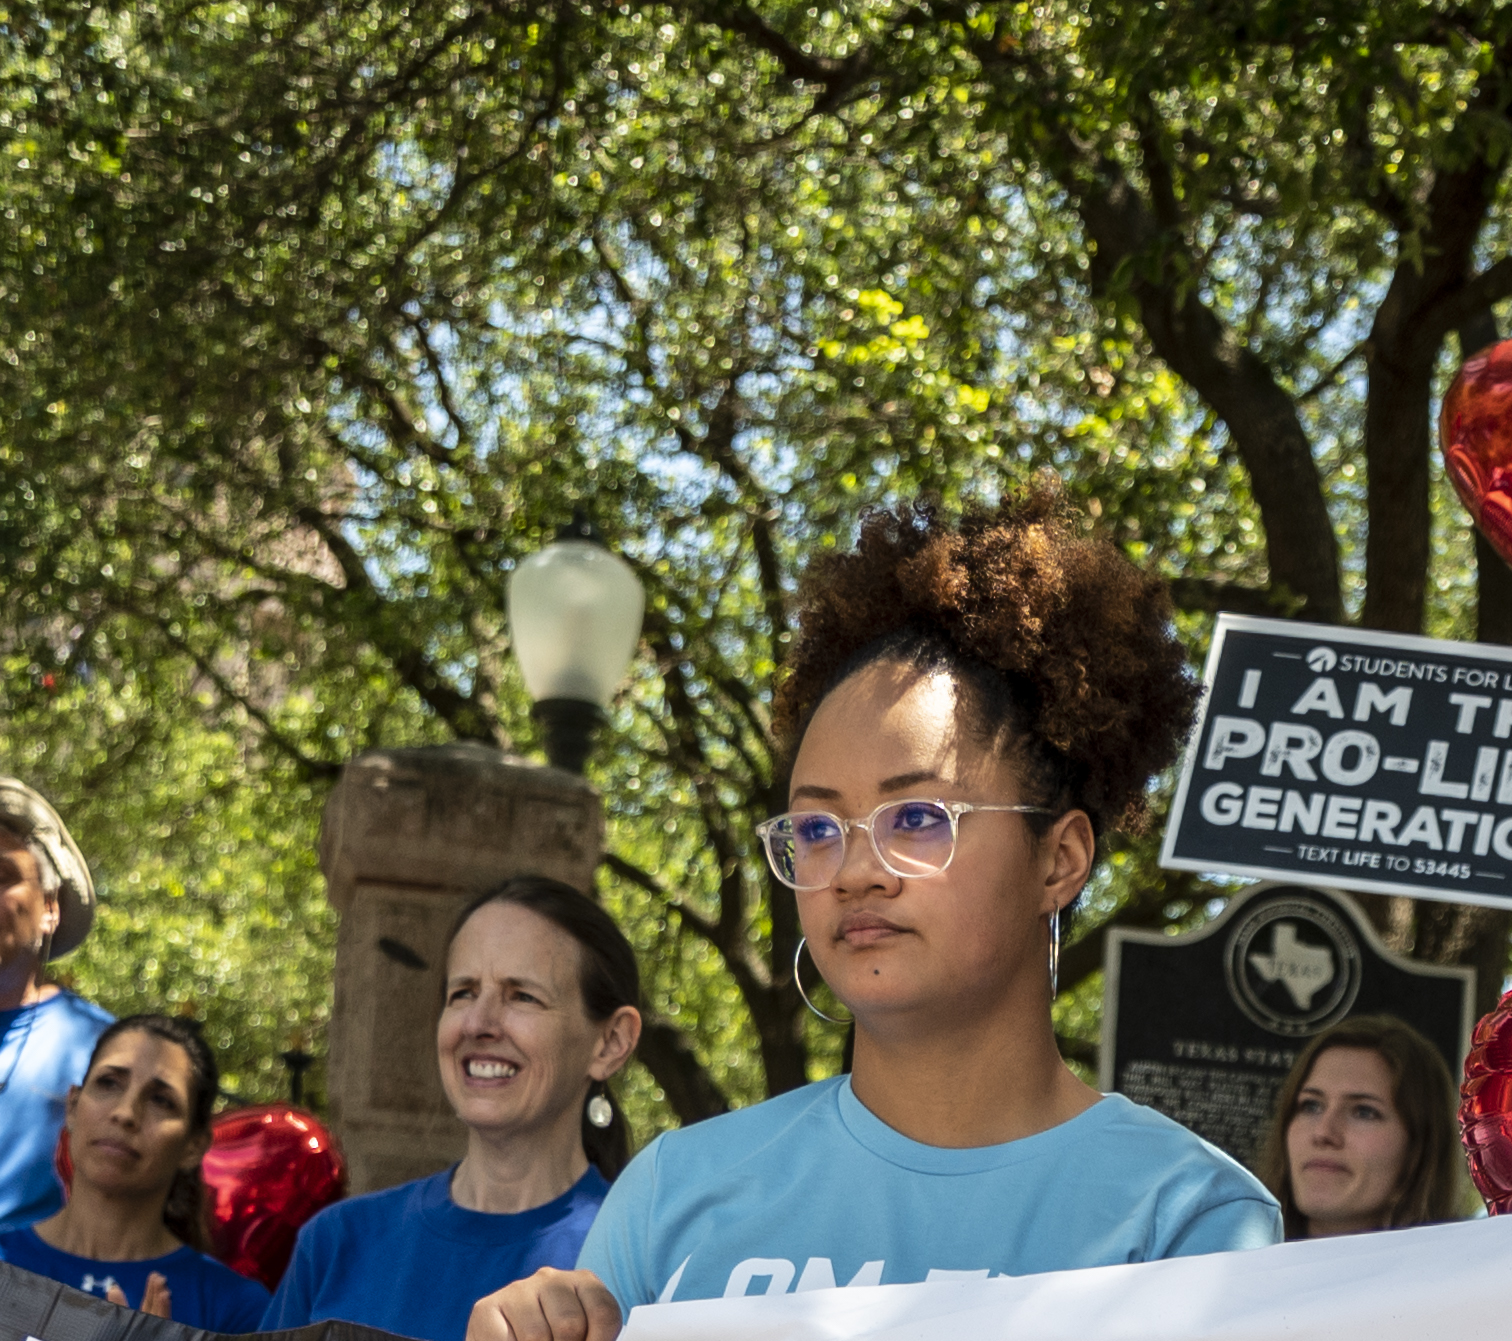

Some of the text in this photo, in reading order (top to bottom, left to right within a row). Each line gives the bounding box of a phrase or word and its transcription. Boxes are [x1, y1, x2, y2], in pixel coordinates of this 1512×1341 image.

[1338, 654, 1447, 683] STUDENTS
[1452, 667, 1499, 689] FOR
[1237, 669, 1262, 708] I
[1291, 677, 1414, 726] AM
[1296, 843, 1472, 880] TEXT LIFE TO 53445
